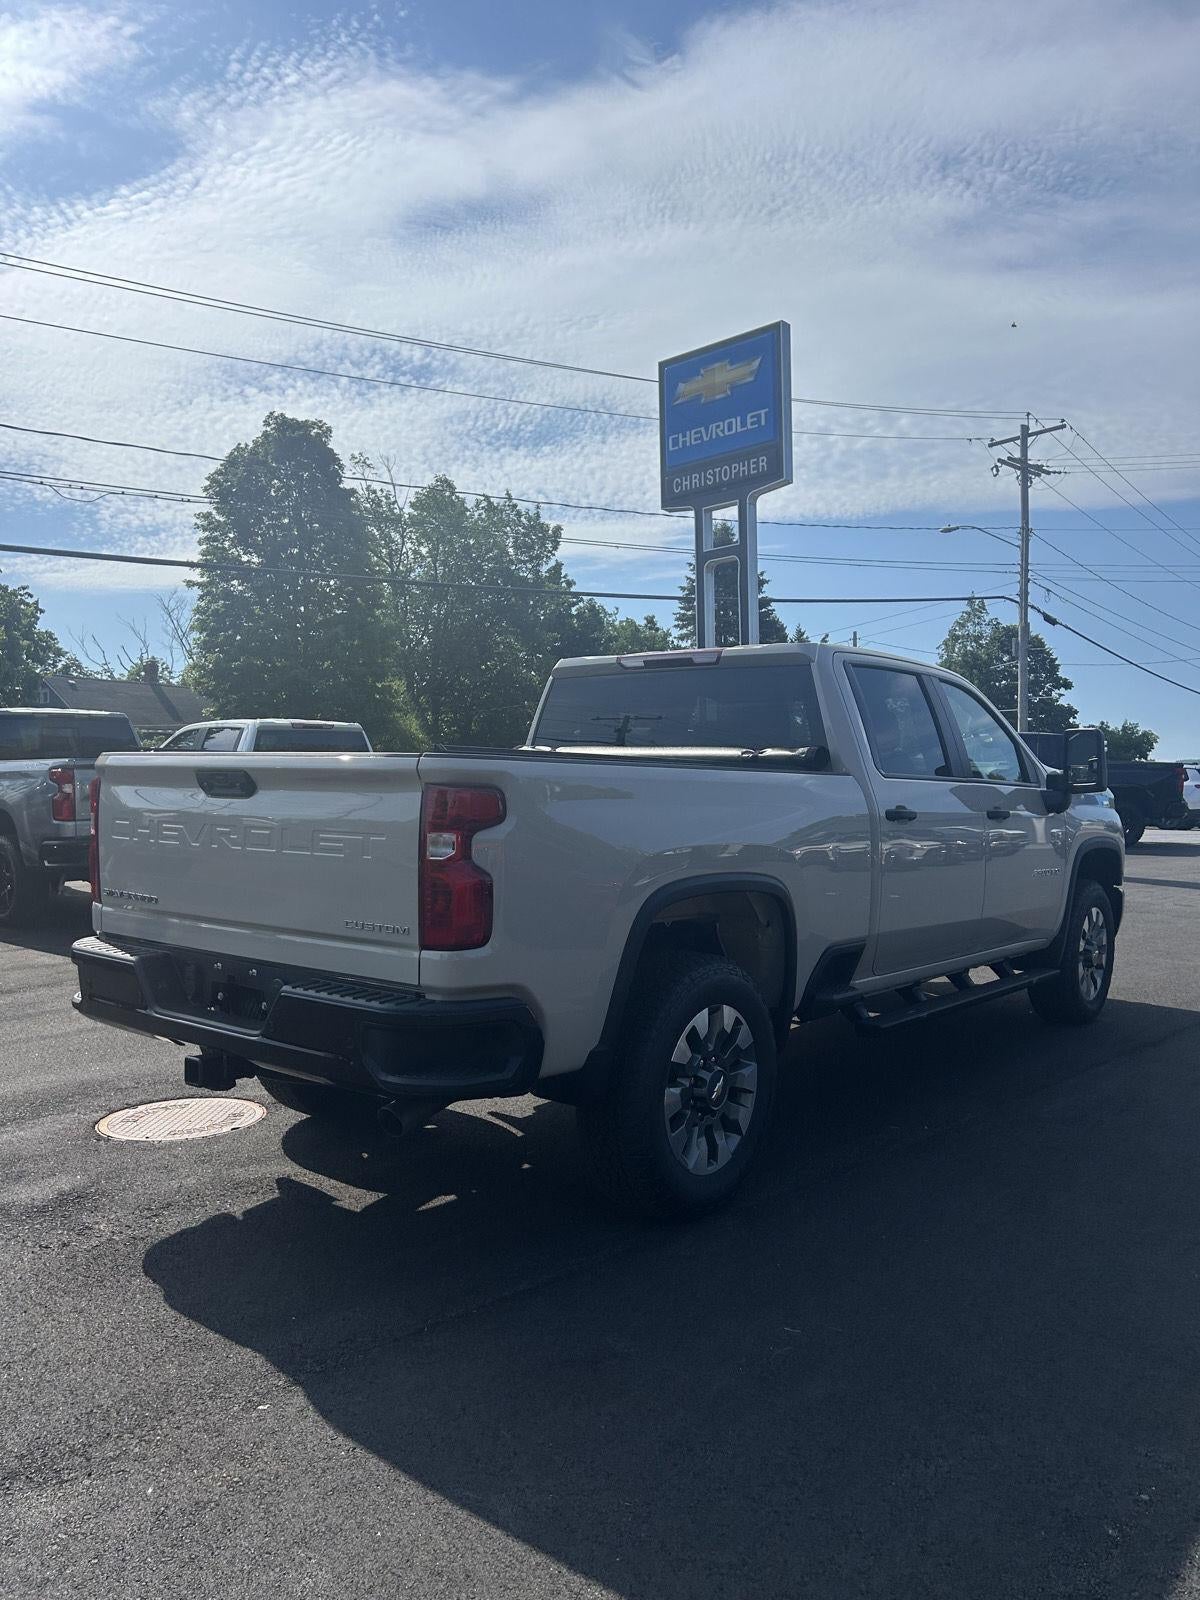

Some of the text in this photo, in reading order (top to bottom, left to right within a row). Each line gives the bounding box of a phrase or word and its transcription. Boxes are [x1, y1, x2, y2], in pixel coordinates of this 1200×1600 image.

[668, 408, 769, 451] CHEVROLET
[673, 456, 768, 493] CHRISTOPHER
[110, 819, 387, 860] CHEVROLET
[343, 919, 410, 936] CUSTOM
